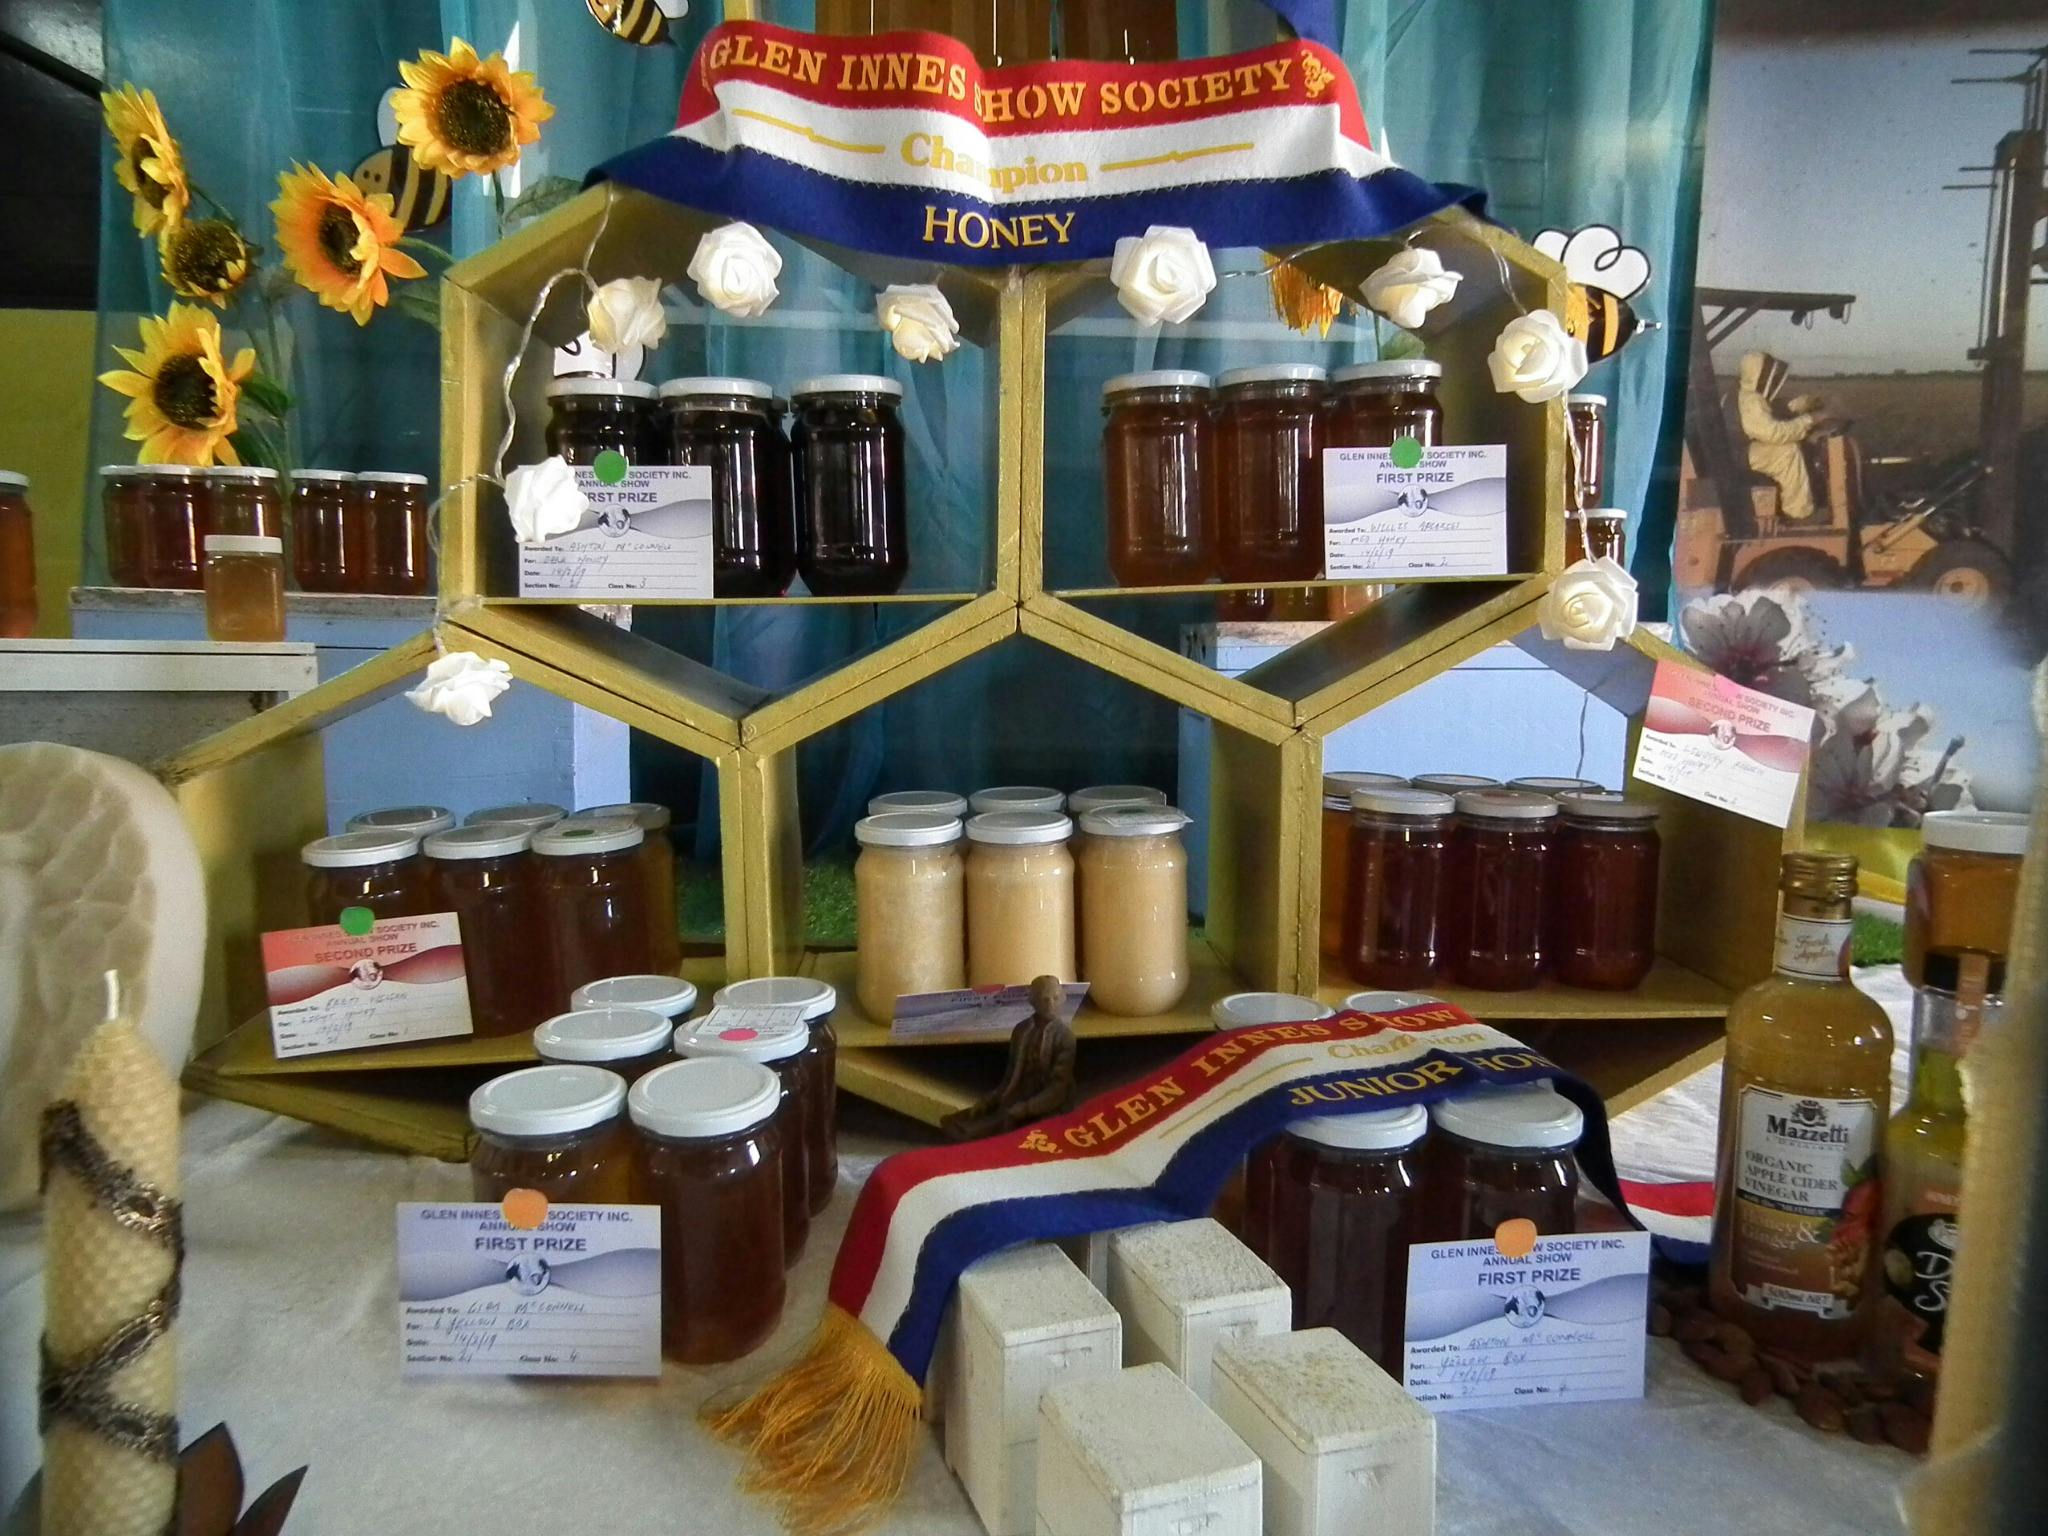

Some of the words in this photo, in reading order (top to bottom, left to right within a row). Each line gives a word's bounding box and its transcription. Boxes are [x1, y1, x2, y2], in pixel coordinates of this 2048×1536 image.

[709, 34, 828, 85] GLEN
[836, 52, 967, 101] INNES
[973, 80, 1087, 123] SHOW
[1099, 58, 1293, 115] SOCIETY
[900, 131, 1088, 194] Champion
[922, 205, 1076, 249] HONEY
[1339, 452, 1365, 461] GLEN
[1366, 452, 1392, 460] INNES
[1427, 450, 1467, 459] SOCIETY
[1468, 450, 1488, 459] INC.
[1419, 460, 1447, 468] SHOW
[575, 471, 594, 479] NES
[629, 471, 670, 480] SOCIETY
[672, 471, 692, 480] INC.
[620, 480, 650, 488] SHOW
[1376, 473, 1413, 484] FIRST
[1416, 472, 1455, 483] PRIZE
[585, 492, 614, 503] RST
[618, 492, 658, 503] PRIZE
[1744, 694, 1779, 714] SOCIETY
[1688, 697, 1736, 721] SECOND
[1737, 713, 1772, 733] PRIZE
[377, 923, 418, 933] SOCIETY
[420, 920, 440, 929] INC.
[369, 933, 399, 943] SHOW
[314, 947, 374, 963] SECOND
[377, 942, 418, 956] PRIZE
[1327, 1030, 1487, 1060] Chamion
[1063, 1076, 1186, 1149] GLEN
[1190, 1024, 1333, 1078] INNES
[1291, 1059, 1464, 1107] JUNIOR
[1766, 1113, 1849, 1144] Mazzetti
[1745, 1150, 1814, 1175] ORGANIC
[1744, 1163, 1787, 1185] APPLE
[1790, 1177, 1839, 1191] CIDER
[1744, 1177, 1809, 1203] VINEGAR
[420, 1209, 458, 1220] GLEN
[460, 1210, 500, 1221] INNES
[548, 1210, 605, 1222] SOCIETY
[607, 1211, 633, 1222] INC.
[535, 1221, 577, 1232] SHOW
[474, 1237, 528, 1250] FIRST
[533, 1238, 587, 1251] PRIZE
[1431, 1246, 1465, 1260] GLEN
[1548, 1240, 1600, 1252] SOCIETY
[1601, 1239, 1625, 1250] INC.
[1482, 1254, 1533, 1267] ANNUAL
[1535, 1252, 1573, 1264] SHOW
[1477, 1270, 1527, 1287] FIRST
[1531, 1267, 1582, 1283] PRIZE
[454, 1332, 498, 1351] 14/2/19
[1410, 1345, 1446, 1355] Awarded
[1448, 1344, 1461, 1352] To:
[1410, 1363, 1425, 1371] For:
[1409, 1378, 1431, 1387] Date:
[1415, 1393, 1438, 1402] ction
[1514, 1387, 1535, 1395] Class
